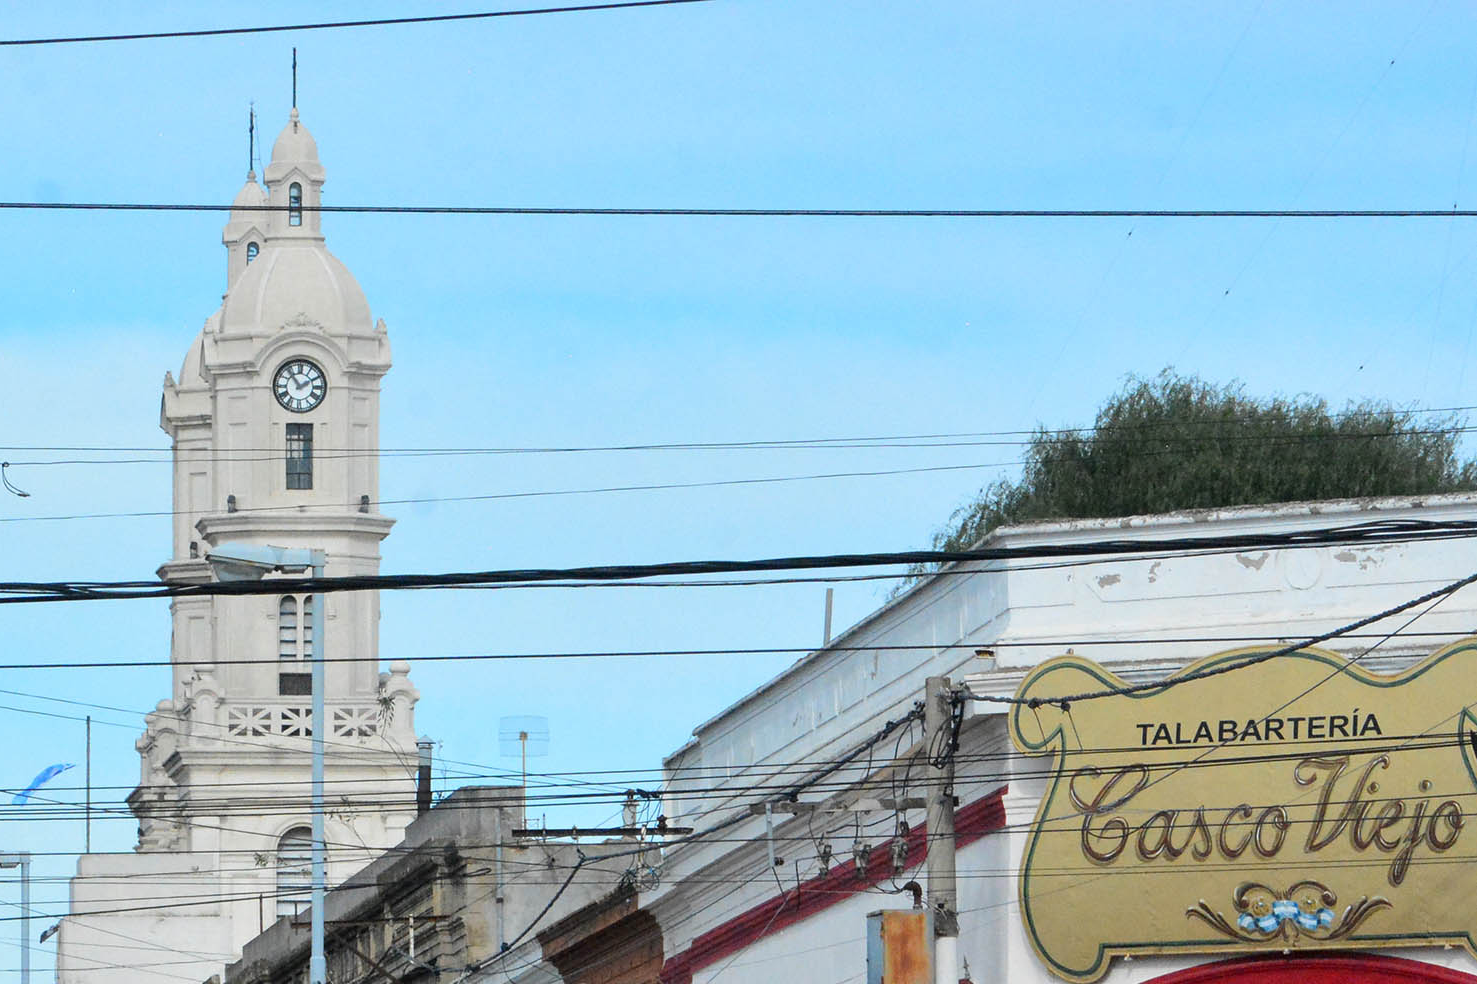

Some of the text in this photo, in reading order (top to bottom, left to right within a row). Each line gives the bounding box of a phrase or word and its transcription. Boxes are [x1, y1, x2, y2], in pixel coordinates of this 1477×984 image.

[1136, 709, 1383, 747] TALABARTERÍA
[1069, 752, 1467, 887] Casco Viejo
